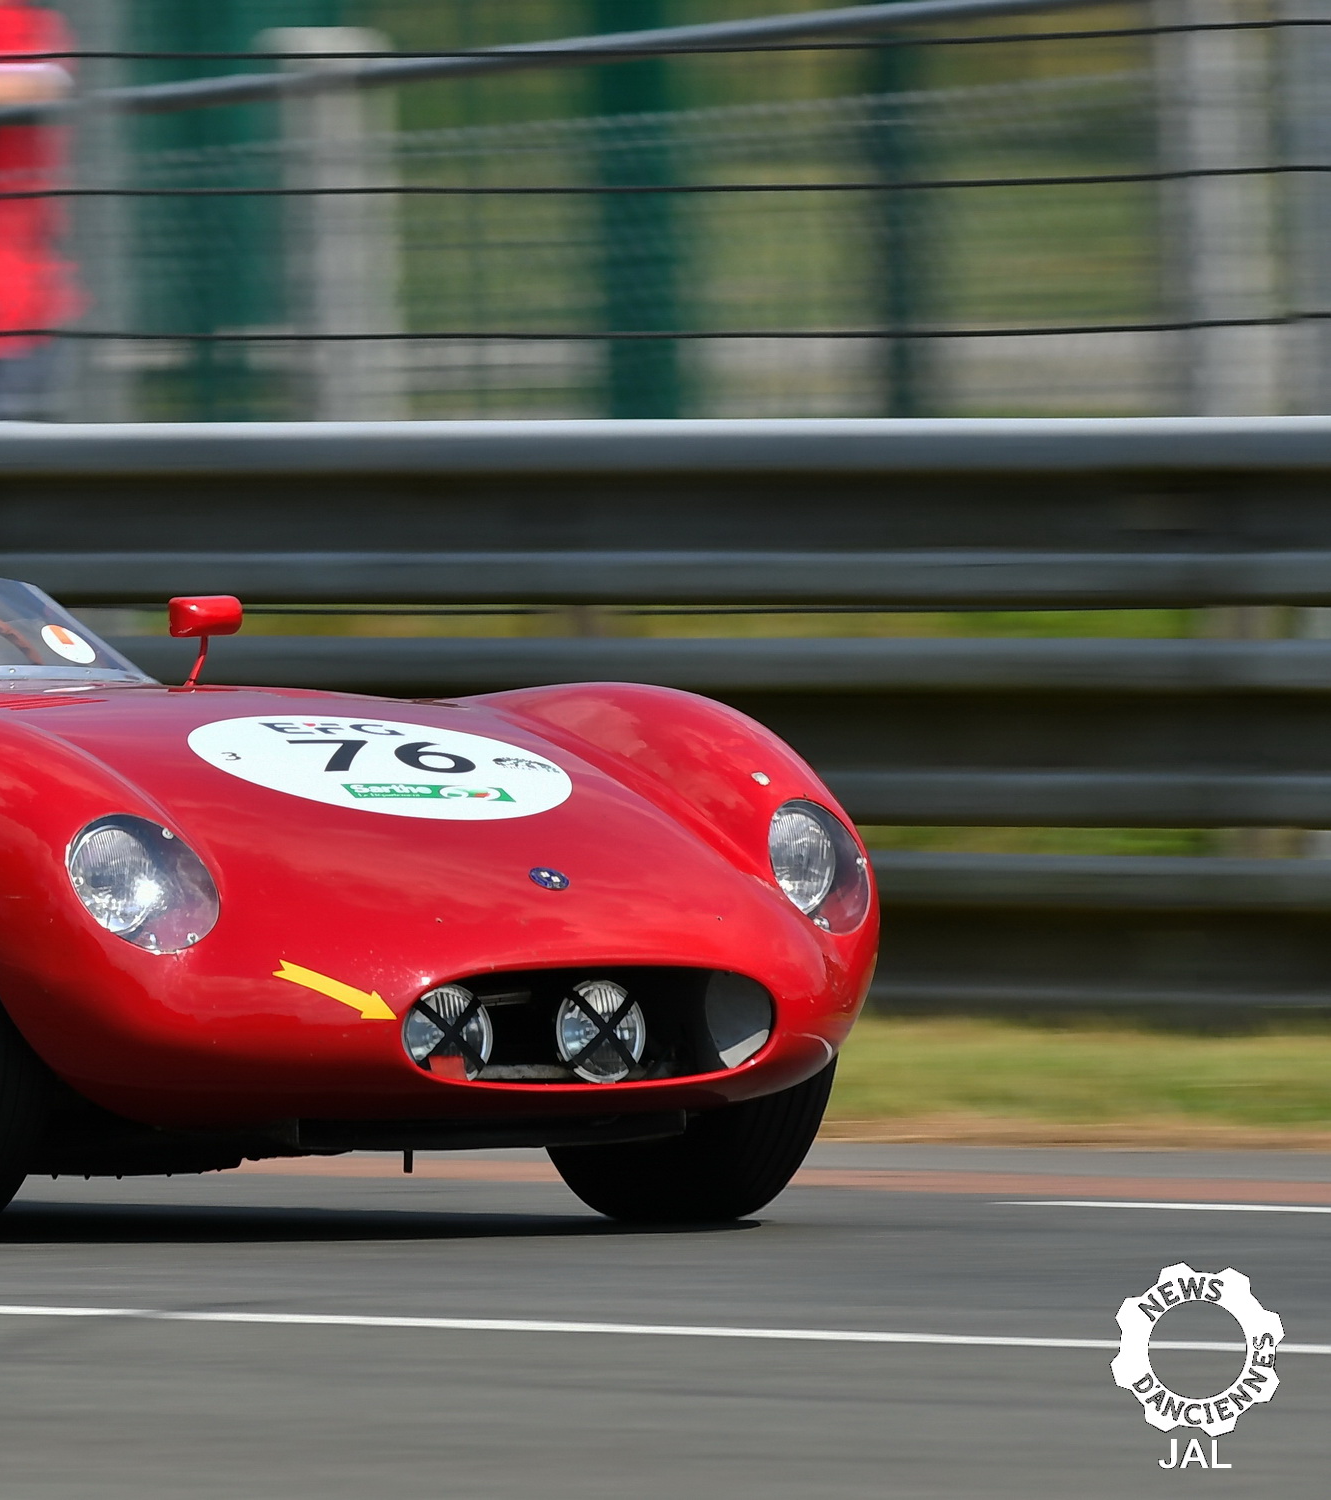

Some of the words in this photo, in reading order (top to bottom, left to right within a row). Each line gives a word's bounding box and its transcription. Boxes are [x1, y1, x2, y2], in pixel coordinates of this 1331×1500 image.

[258, 722, 405, 736] EFG
[220, 751, 242, 761] 3
[286, 739, 476, 774] 76
[349, 784, 433, 795] Sarthe
